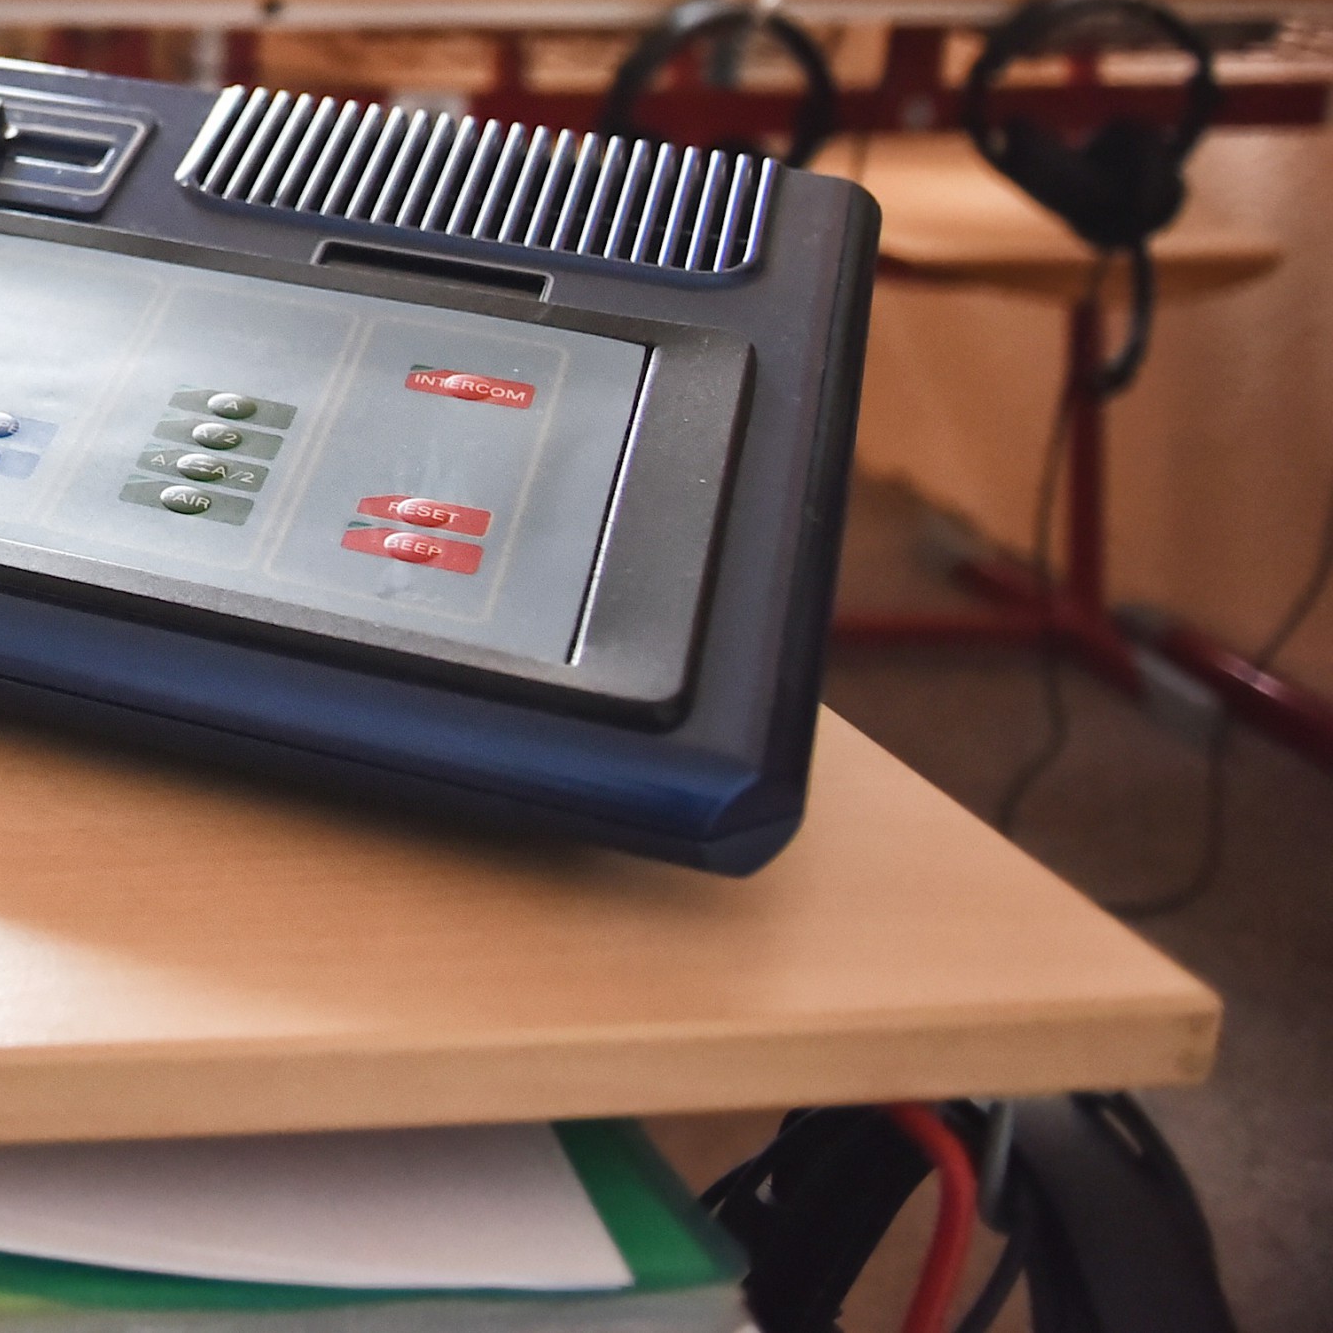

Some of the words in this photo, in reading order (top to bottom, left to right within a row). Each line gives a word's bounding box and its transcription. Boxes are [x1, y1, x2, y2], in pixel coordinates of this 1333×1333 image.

[414, 372, 527, 403] INTERCOM
[223, 400, 239, 411] A
[165, 489, 211, 510] PAIR
[388, 500, 460, 524] RESET
[386, 537, 443, 558] BEEP
